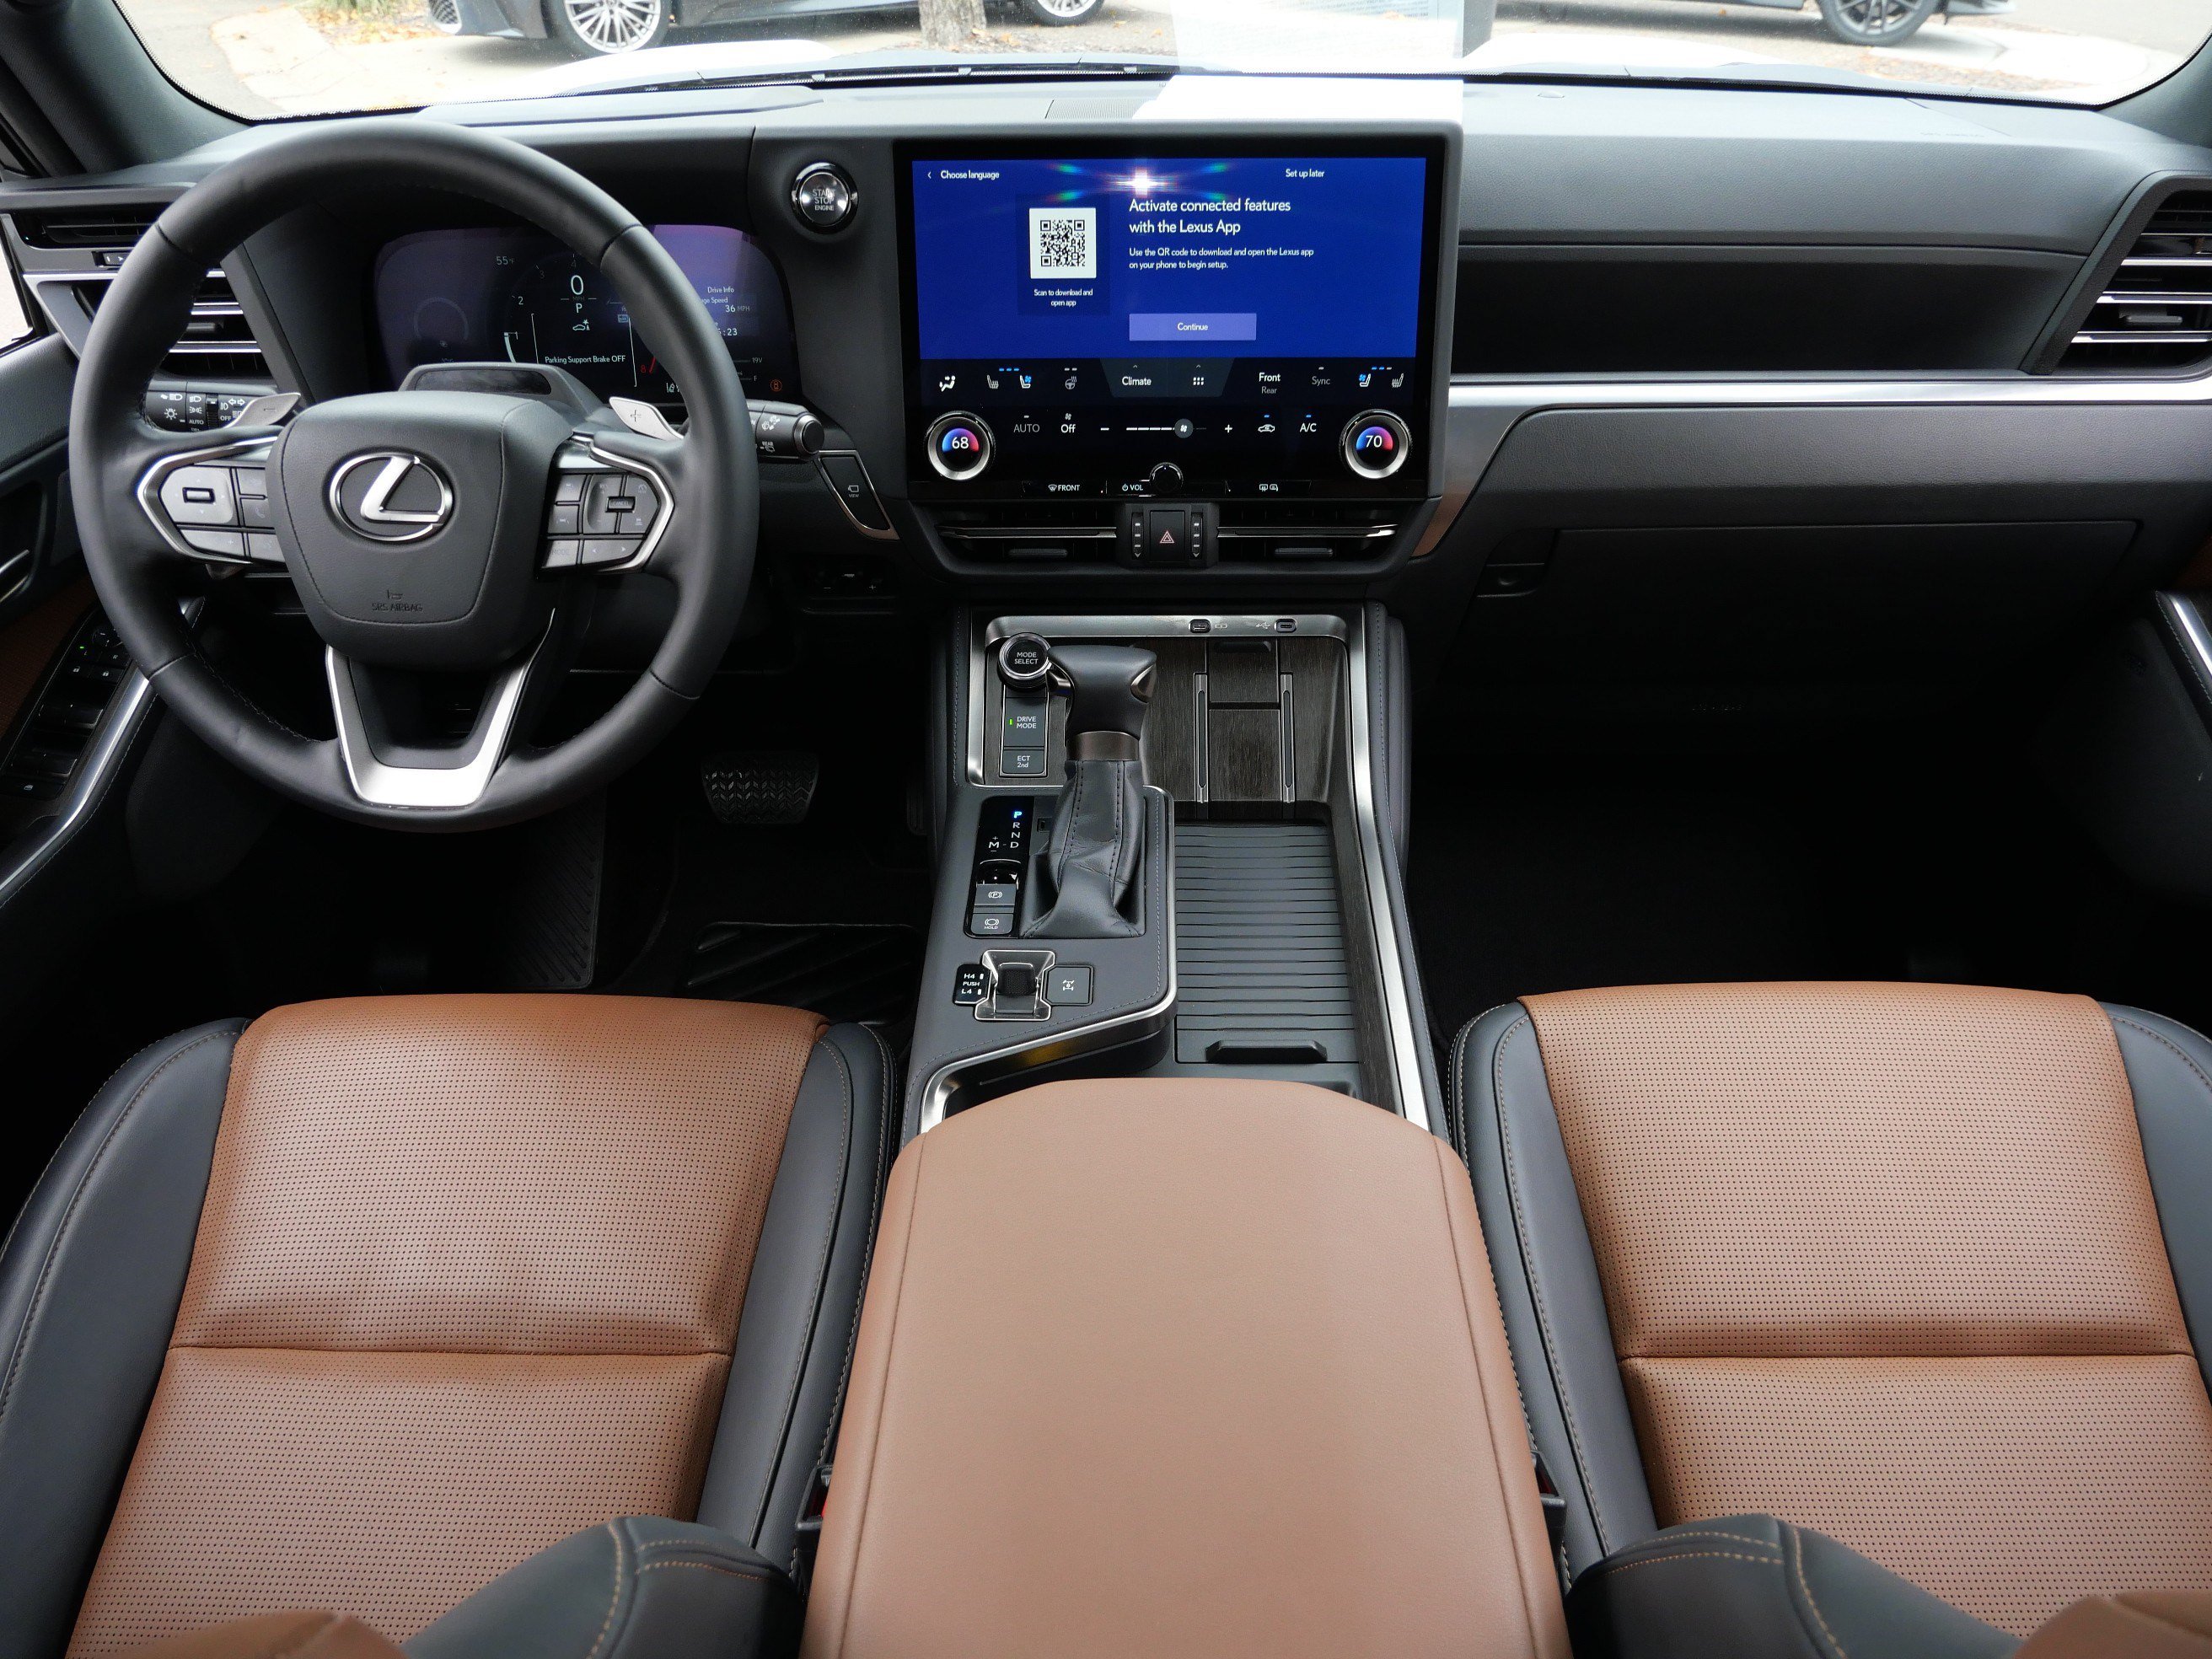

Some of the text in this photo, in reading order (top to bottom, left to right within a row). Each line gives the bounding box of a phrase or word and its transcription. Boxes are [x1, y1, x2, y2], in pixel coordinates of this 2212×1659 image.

[941, 170, 1000, 180] Choose language
[1286, 168, 1324, 180] Set up later
[813, 189, 835, 197] START
[814, 196, 834, 205] STOP
[1129, 198, 1291, 212] Activate connected features
[1129, 219, 1241, 236] with the Lexus App
[1129, 247, 1314, 259] Use the QR code to download and open the Lexus app
[1139, 261, 1155, 271] your
[1156, 260, 1178, 271] phone
[1178, 260, 1186, 269] to
[1187, 260, 1206, 271] begin
[1207, 260, 1229, 271] setup.
[1034, 288, 1047, 297] Scan
[1055, 288, 1082, 297] download
[1082, 288, 1093, 297] and
[518, 296, 524, 305] 2
[576, 303, 583, 314] P
[725, 304, 736, 313] 36
[1177, 322, 1209, 331] Continue
[545, 356, 567, 365] Parking
[567, 356, 592, 364] Support
[593, 355, 610, 363] Brake
[640, 364, 647, 373] 8
[1121, 376, 1152, 386] Climate
[1259, 372, 1281, 383] Front
[1312, 376, 1331, 387] Sync
[1261, 386, 1278, 395] Rear
[1013, 423, 1040, 433] AUTO
[1060, 423, 1076, 433] Off
[1299, 422, 1317, 432] A/C
[952, 436, 969, 450] 68
[1365, 435, 1382, 448] 70
